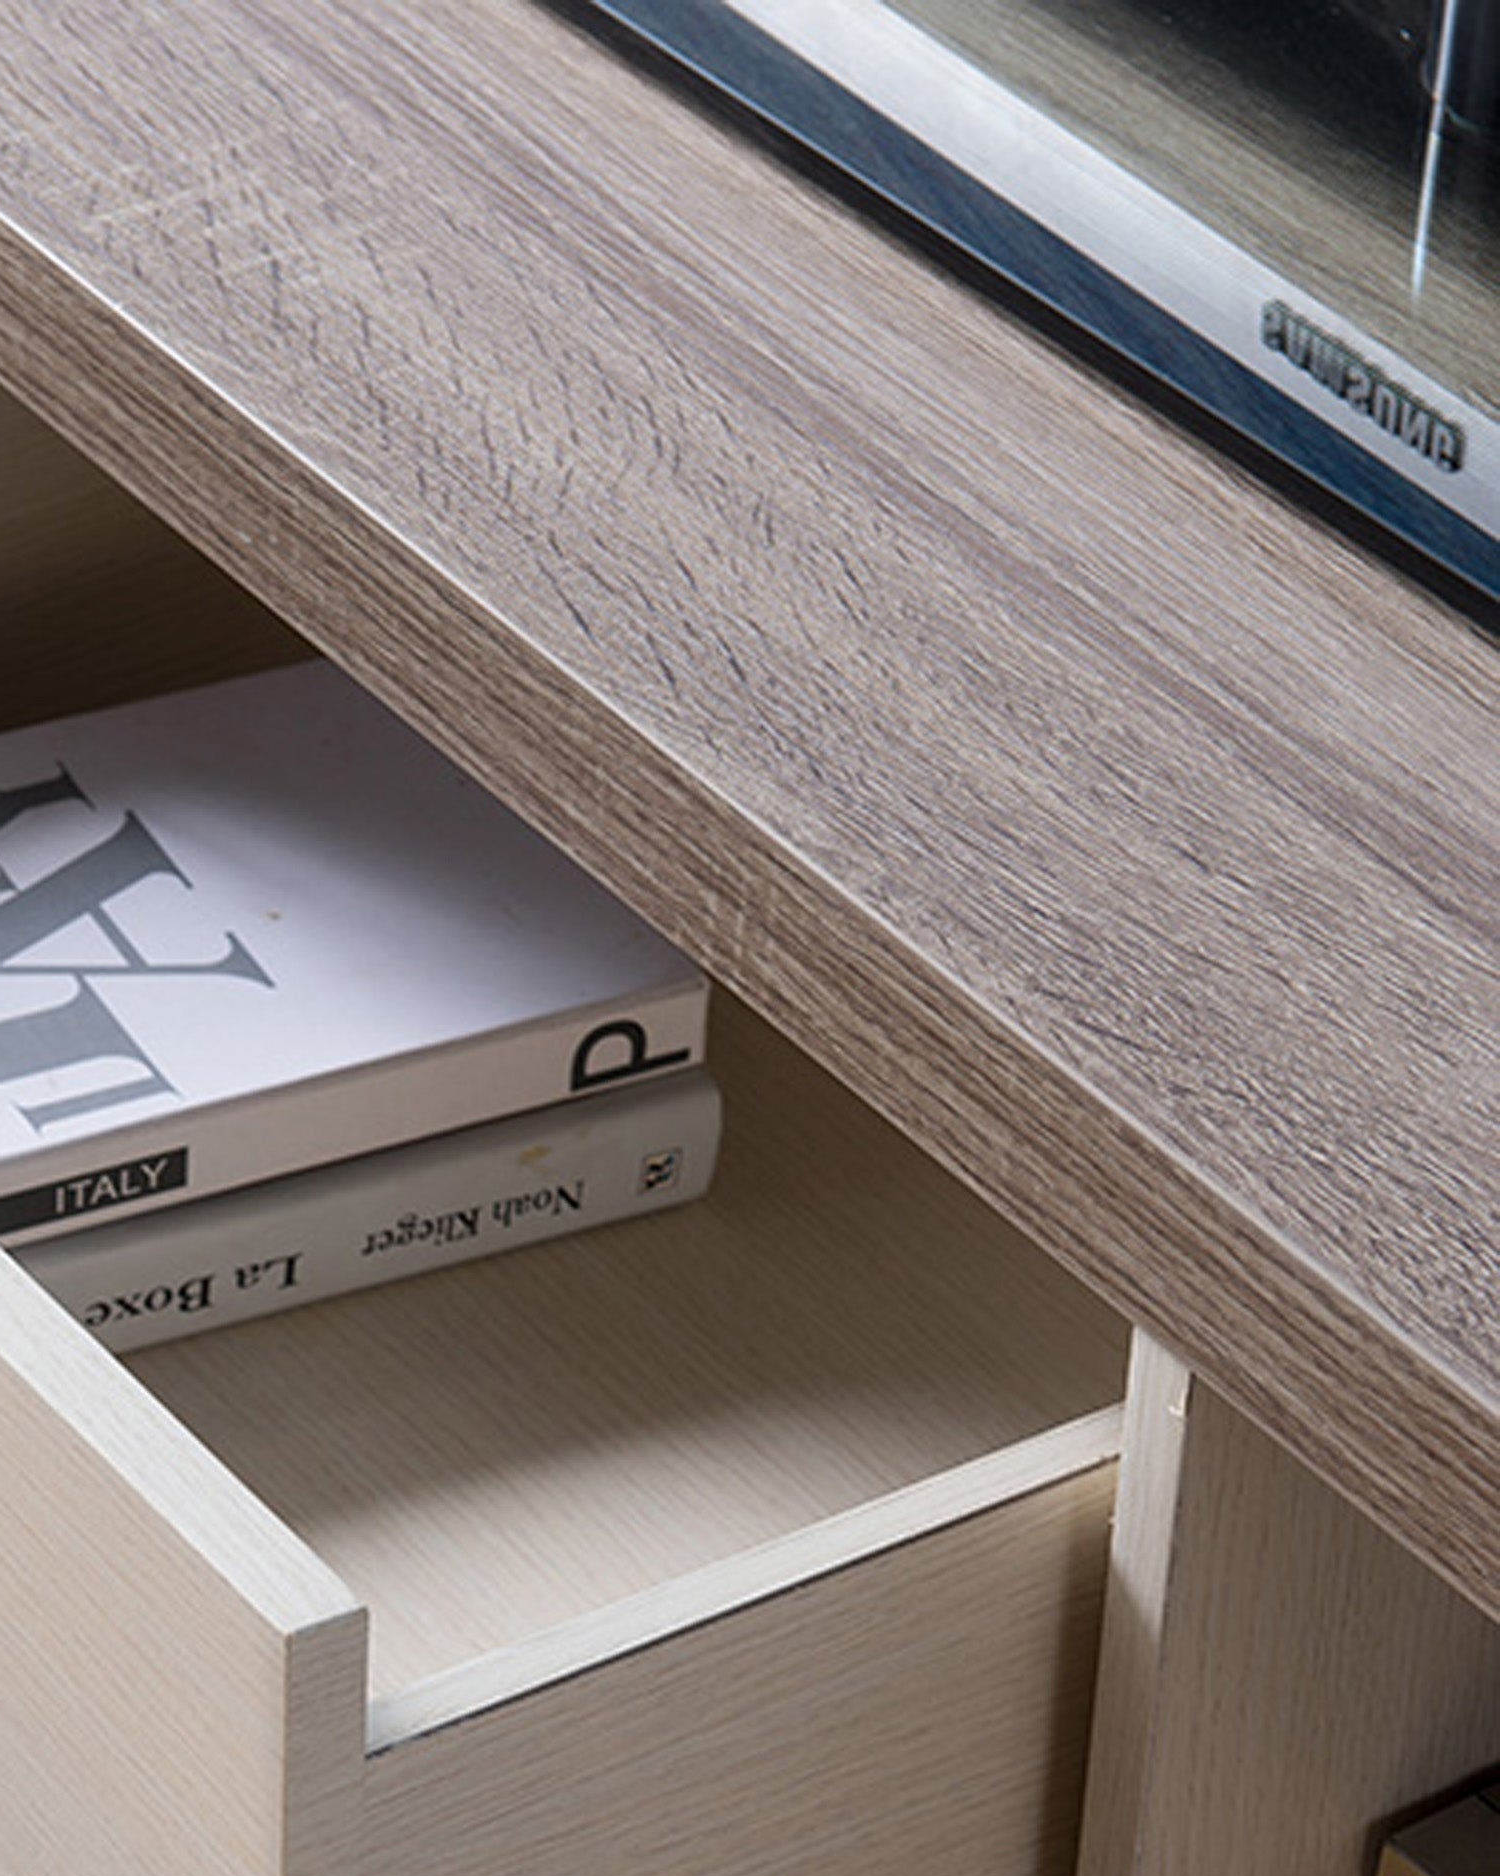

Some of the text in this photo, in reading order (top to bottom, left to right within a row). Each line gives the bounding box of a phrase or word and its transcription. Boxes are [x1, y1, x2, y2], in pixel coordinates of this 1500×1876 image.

[570, 1018, 691, 1091] P
[54, 1158, 170, 1214] ITALY
[83, 1180, 585, 1327] Noah Klieger La Boxe
